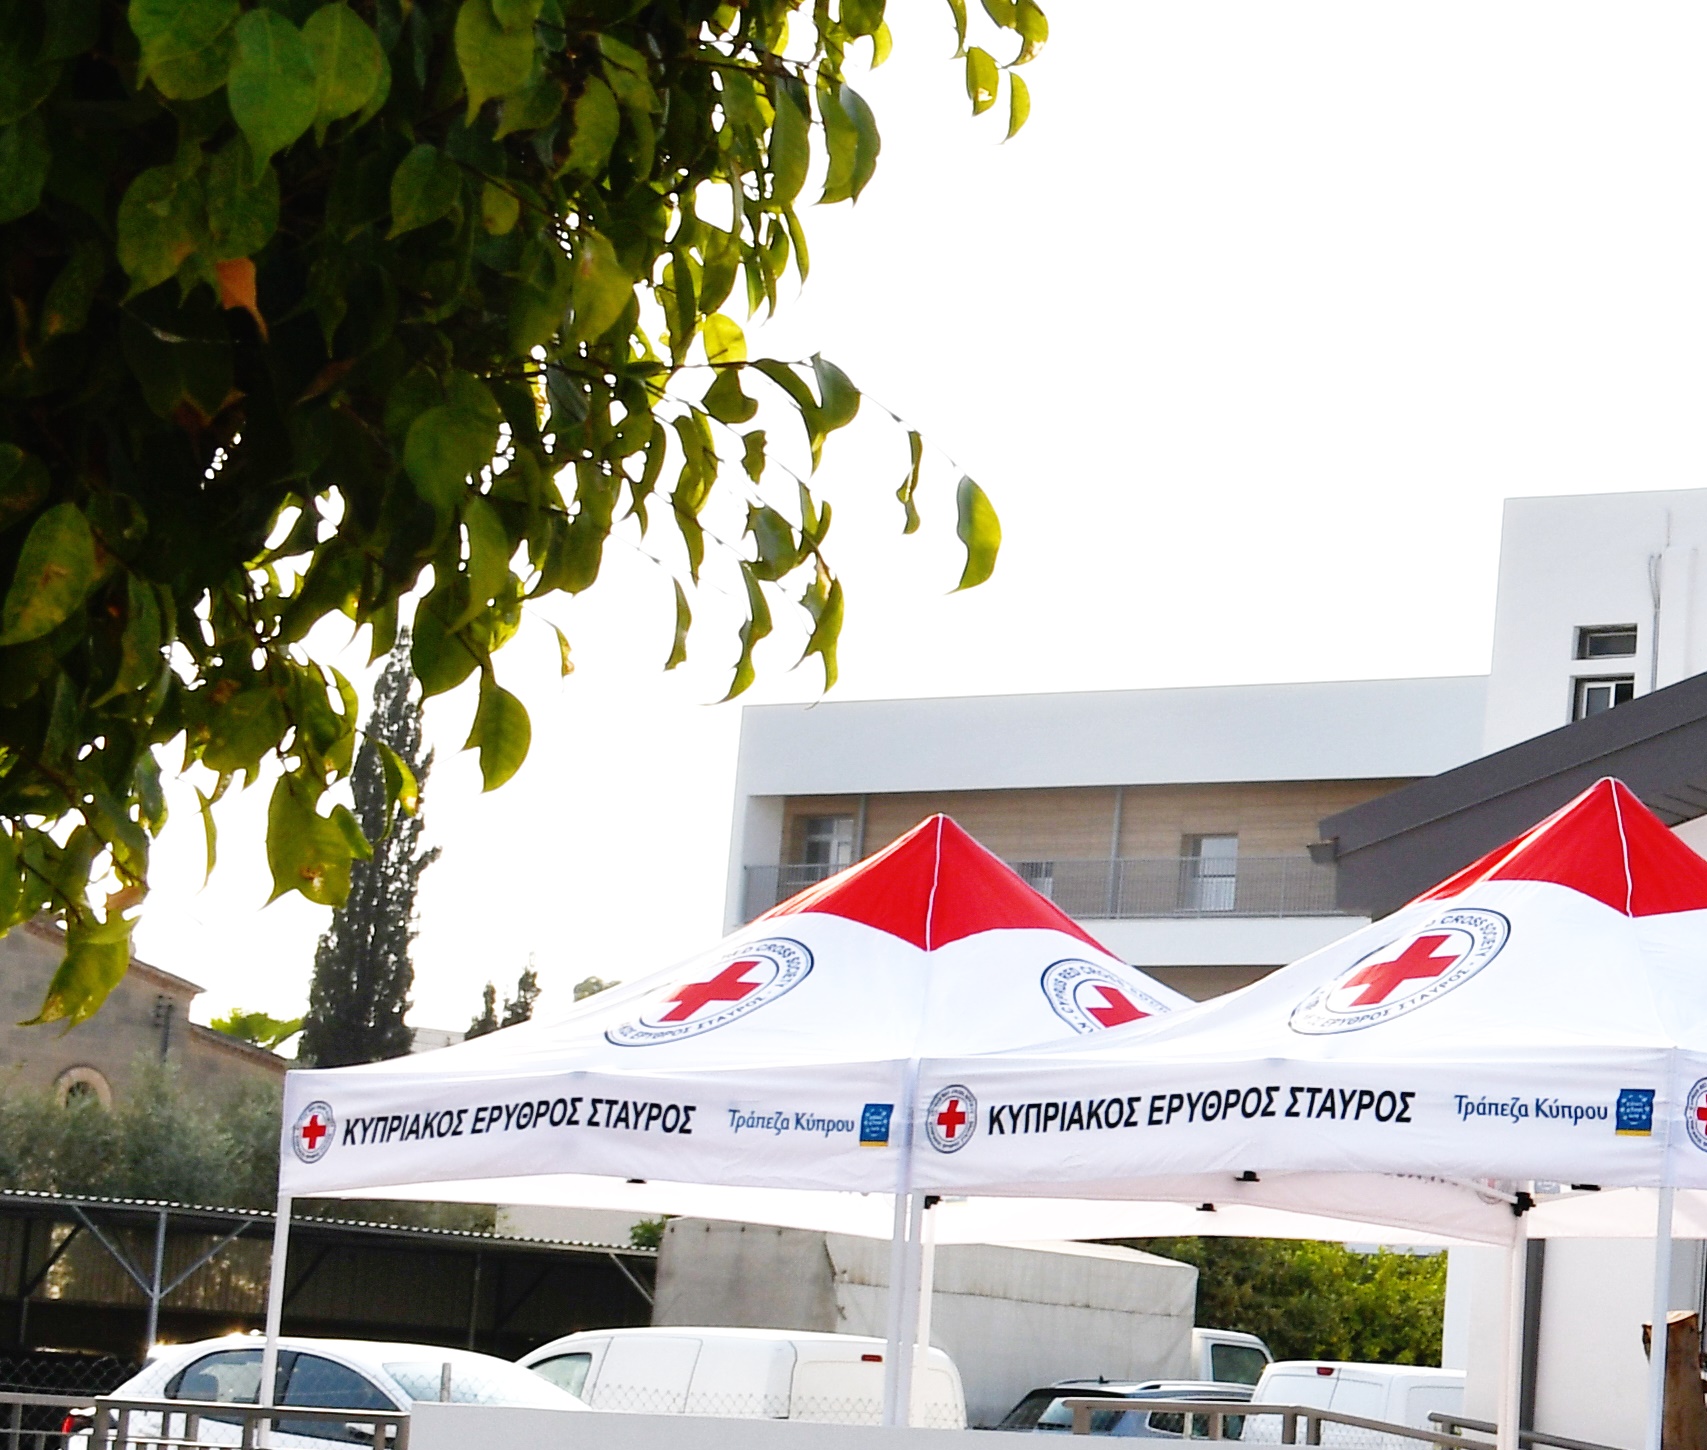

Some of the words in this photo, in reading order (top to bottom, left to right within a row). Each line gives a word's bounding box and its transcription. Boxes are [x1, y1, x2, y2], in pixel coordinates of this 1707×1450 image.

[342, 1109, 469, 1146] ΚΥΠΡΙΑΚΟΣ
[470, 1097, 583, 1134] ΕΡΥΘΡΟΣ
[587, 1098, 696, 1134] ΣΤΑΥΡΟΣ
[728, 1109, 789, 1135] Τράπεζα
[795, 1113, 854, 1138] Κύπρου
[988, 1096, 1142, 1135] ΚΥΠΡΙΑΚΟΣ
[1147, 1086, 1280, 1126] ΕΡΥΘΡΟΣ
[1285, 1086, 1416, 1123] ΣΤΑΥΡΟΣ
[1454, 1095, 1529, 1123] Τράπεζα
[1535, 1098, 1607, 1126] Κύπρου
